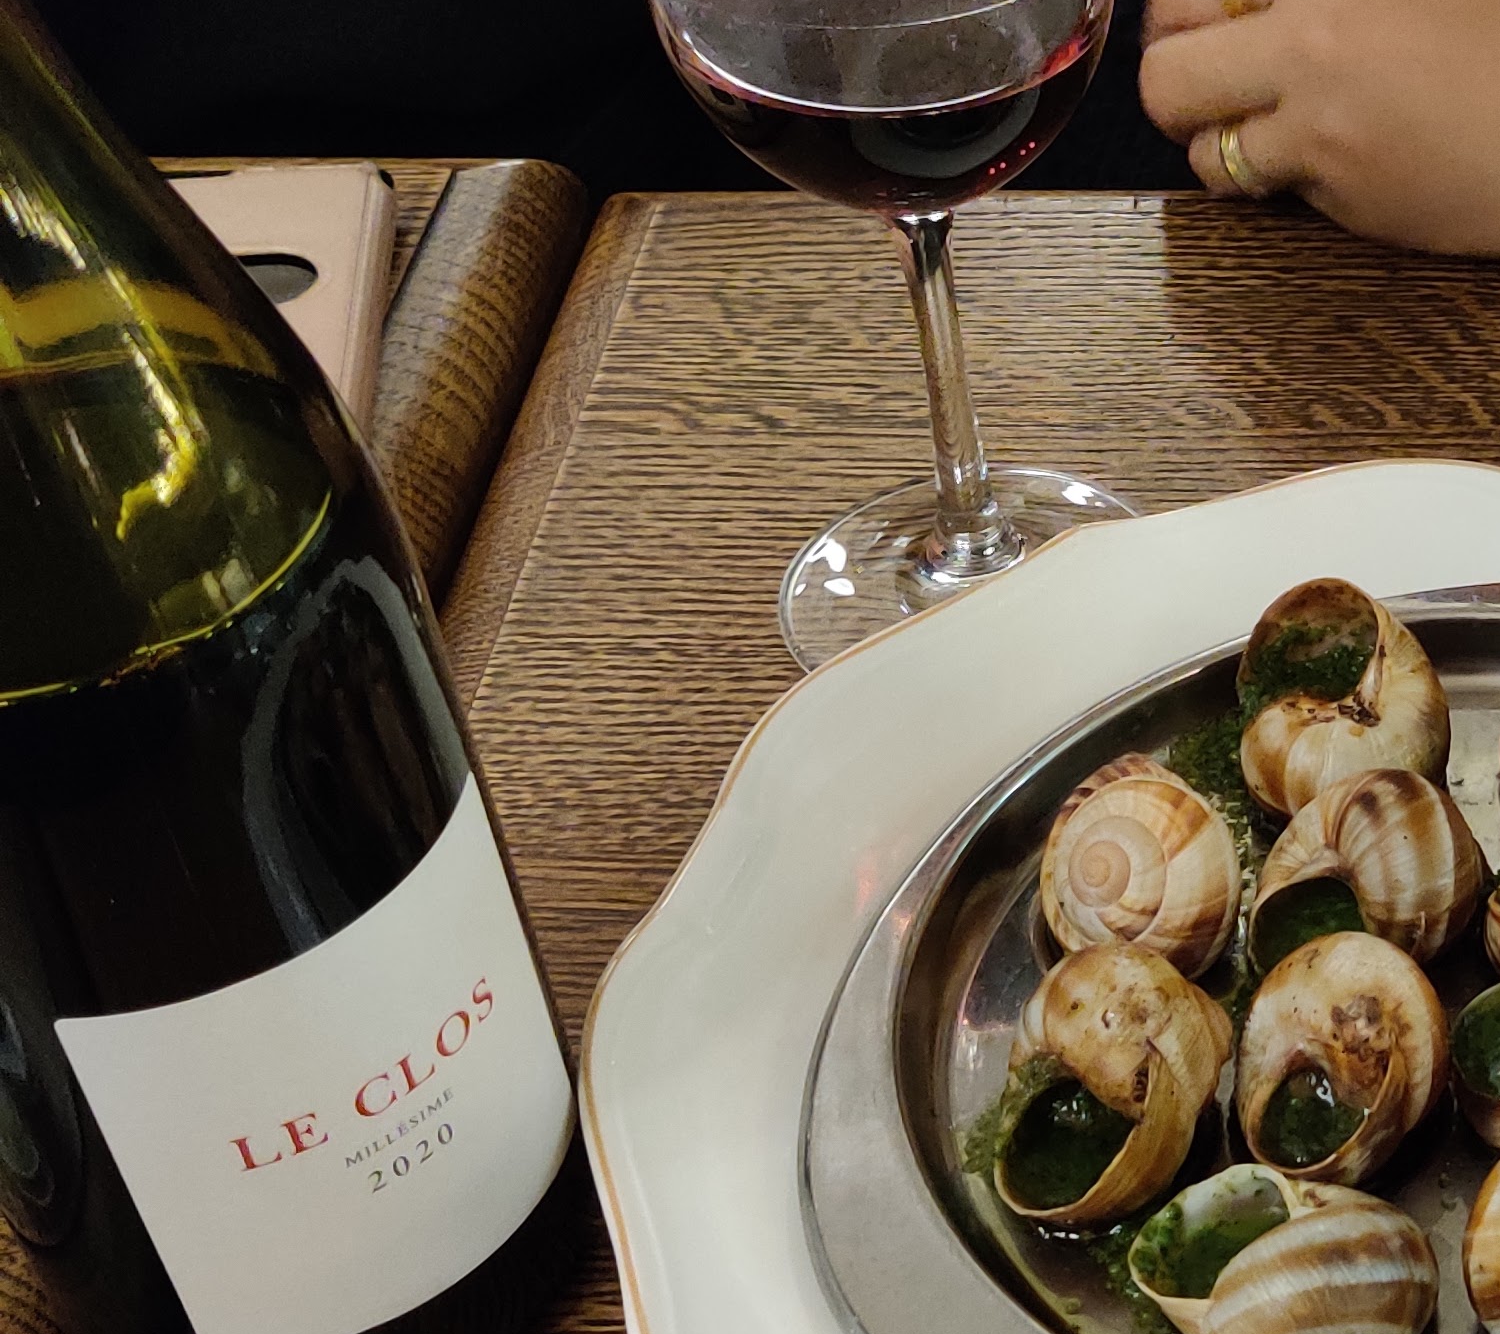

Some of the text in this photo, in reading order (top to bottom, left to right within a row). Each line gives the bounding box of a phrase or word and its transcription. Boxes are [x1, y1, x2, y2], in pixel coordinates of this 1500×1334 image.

[229, 976, 493, 1171] LE CLOS
[368, 1123, 454, 1193] 2020
